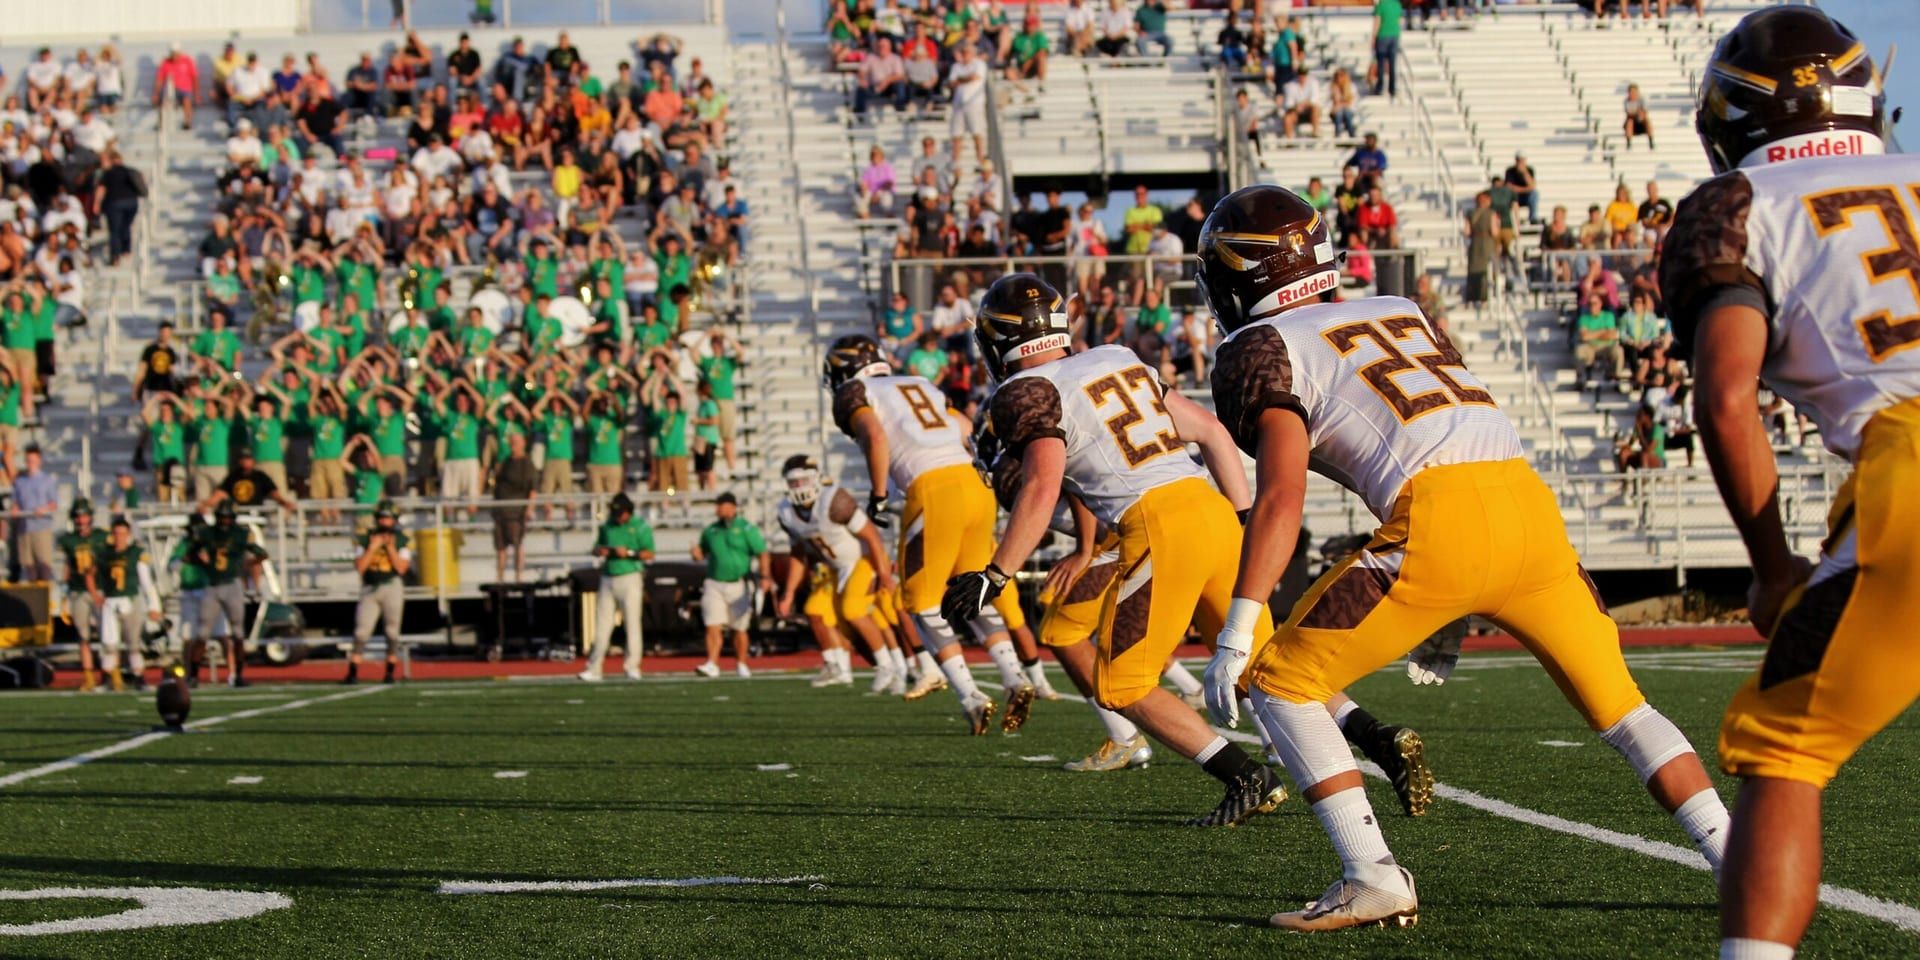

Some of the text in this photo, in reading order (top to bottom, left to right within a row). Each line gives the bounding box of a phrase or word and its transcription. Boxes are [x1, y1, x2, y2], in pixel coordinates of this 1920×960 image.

[1792, 66, 1818, 88] 35
[1767, 135, 1863, 163] Riddell
[1026, 288, 1040, 298] 23
[1277, 273, 1335, 305] Riddell
[1020, 335, 1066, 356] Riddell
[1319, 313, 1499, 427] 22
[896, 384, 948, 430] 8
[1083, 364, 1185, 470] 23
